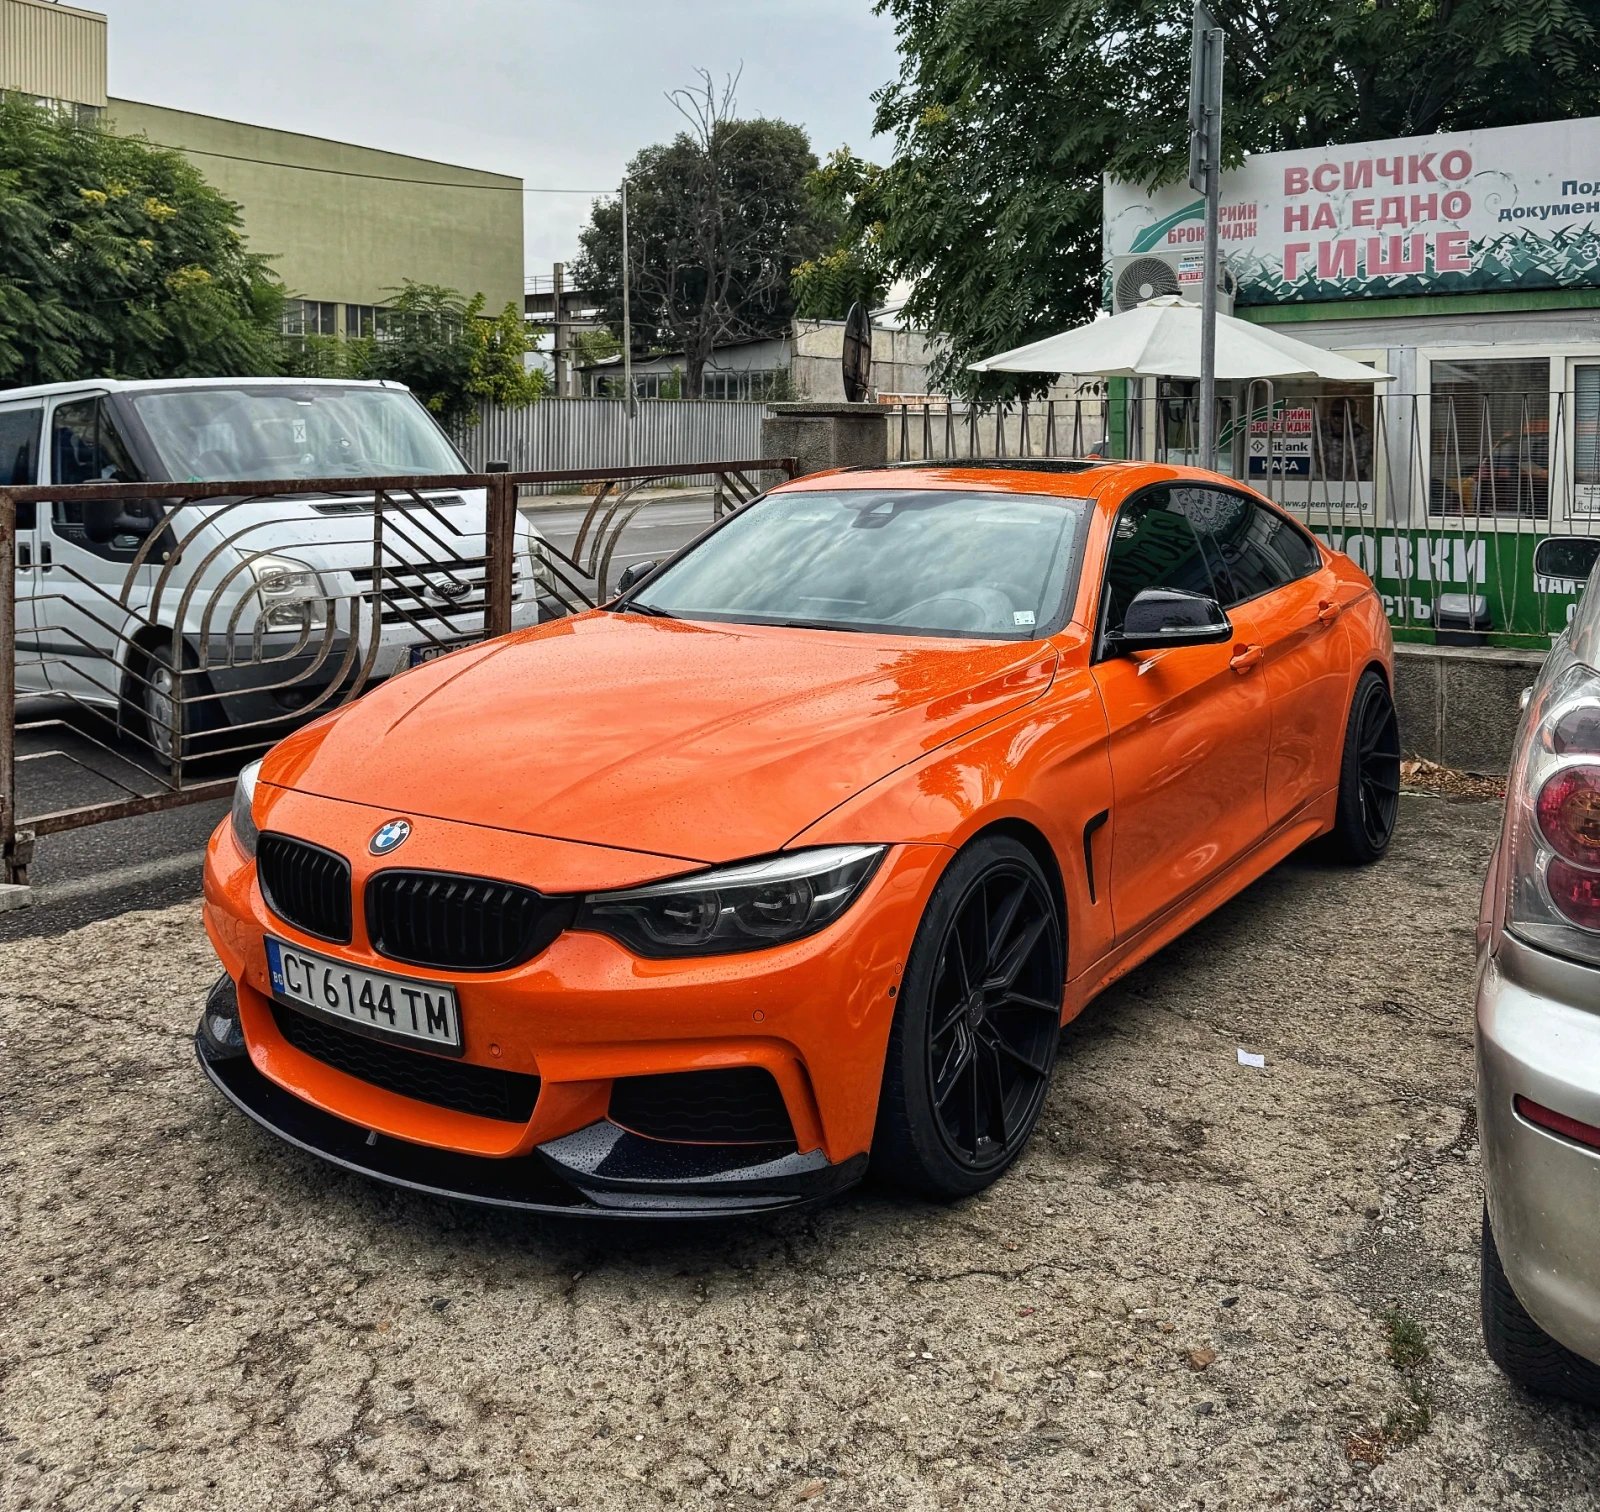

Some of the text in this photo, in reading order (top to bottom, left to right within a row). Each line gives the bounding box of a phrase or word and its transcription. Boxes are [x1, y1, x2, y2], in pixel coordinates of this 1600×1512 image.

[1284, 150, 1472, 196] ВСИЧКО
[1217, 202, 1257, 222] РИЙН
[1284, 191, 1471, 232] НА ЕДНО
[1167, 221, 1257, 244] БРОКИДЖ
[1284, 231, 1471, 280] ГИШЕ
[1250, 421, 1311, 434] БРОЕИДЖ
[1273, 442, 1308, 451] ibank
[443, 582, 465, 594] Ford
[273, 971, 284, 986] BG
[284, 953, 449, 1038] CT 6144 TM
